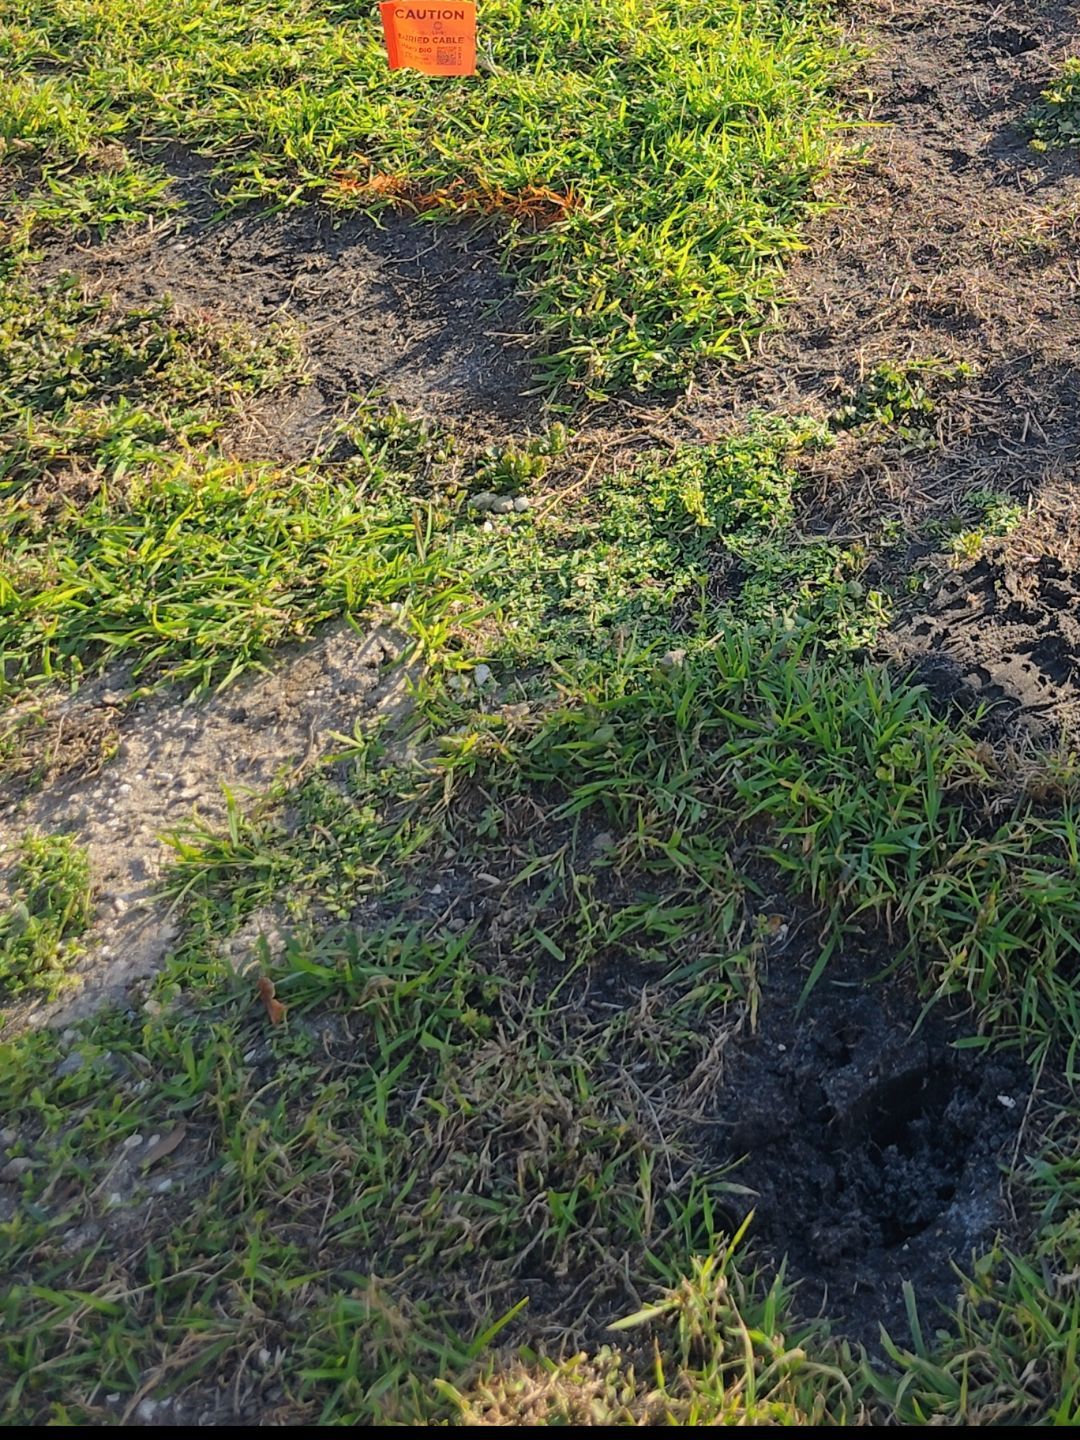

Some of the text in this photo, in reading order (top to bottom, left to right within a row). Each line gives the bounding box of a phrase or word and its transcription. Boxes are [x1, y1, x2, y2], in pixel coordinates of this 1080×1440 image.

[395, 8, 465, 20] CAUTION
[398, 33, 465, 44] RIED CABLE
